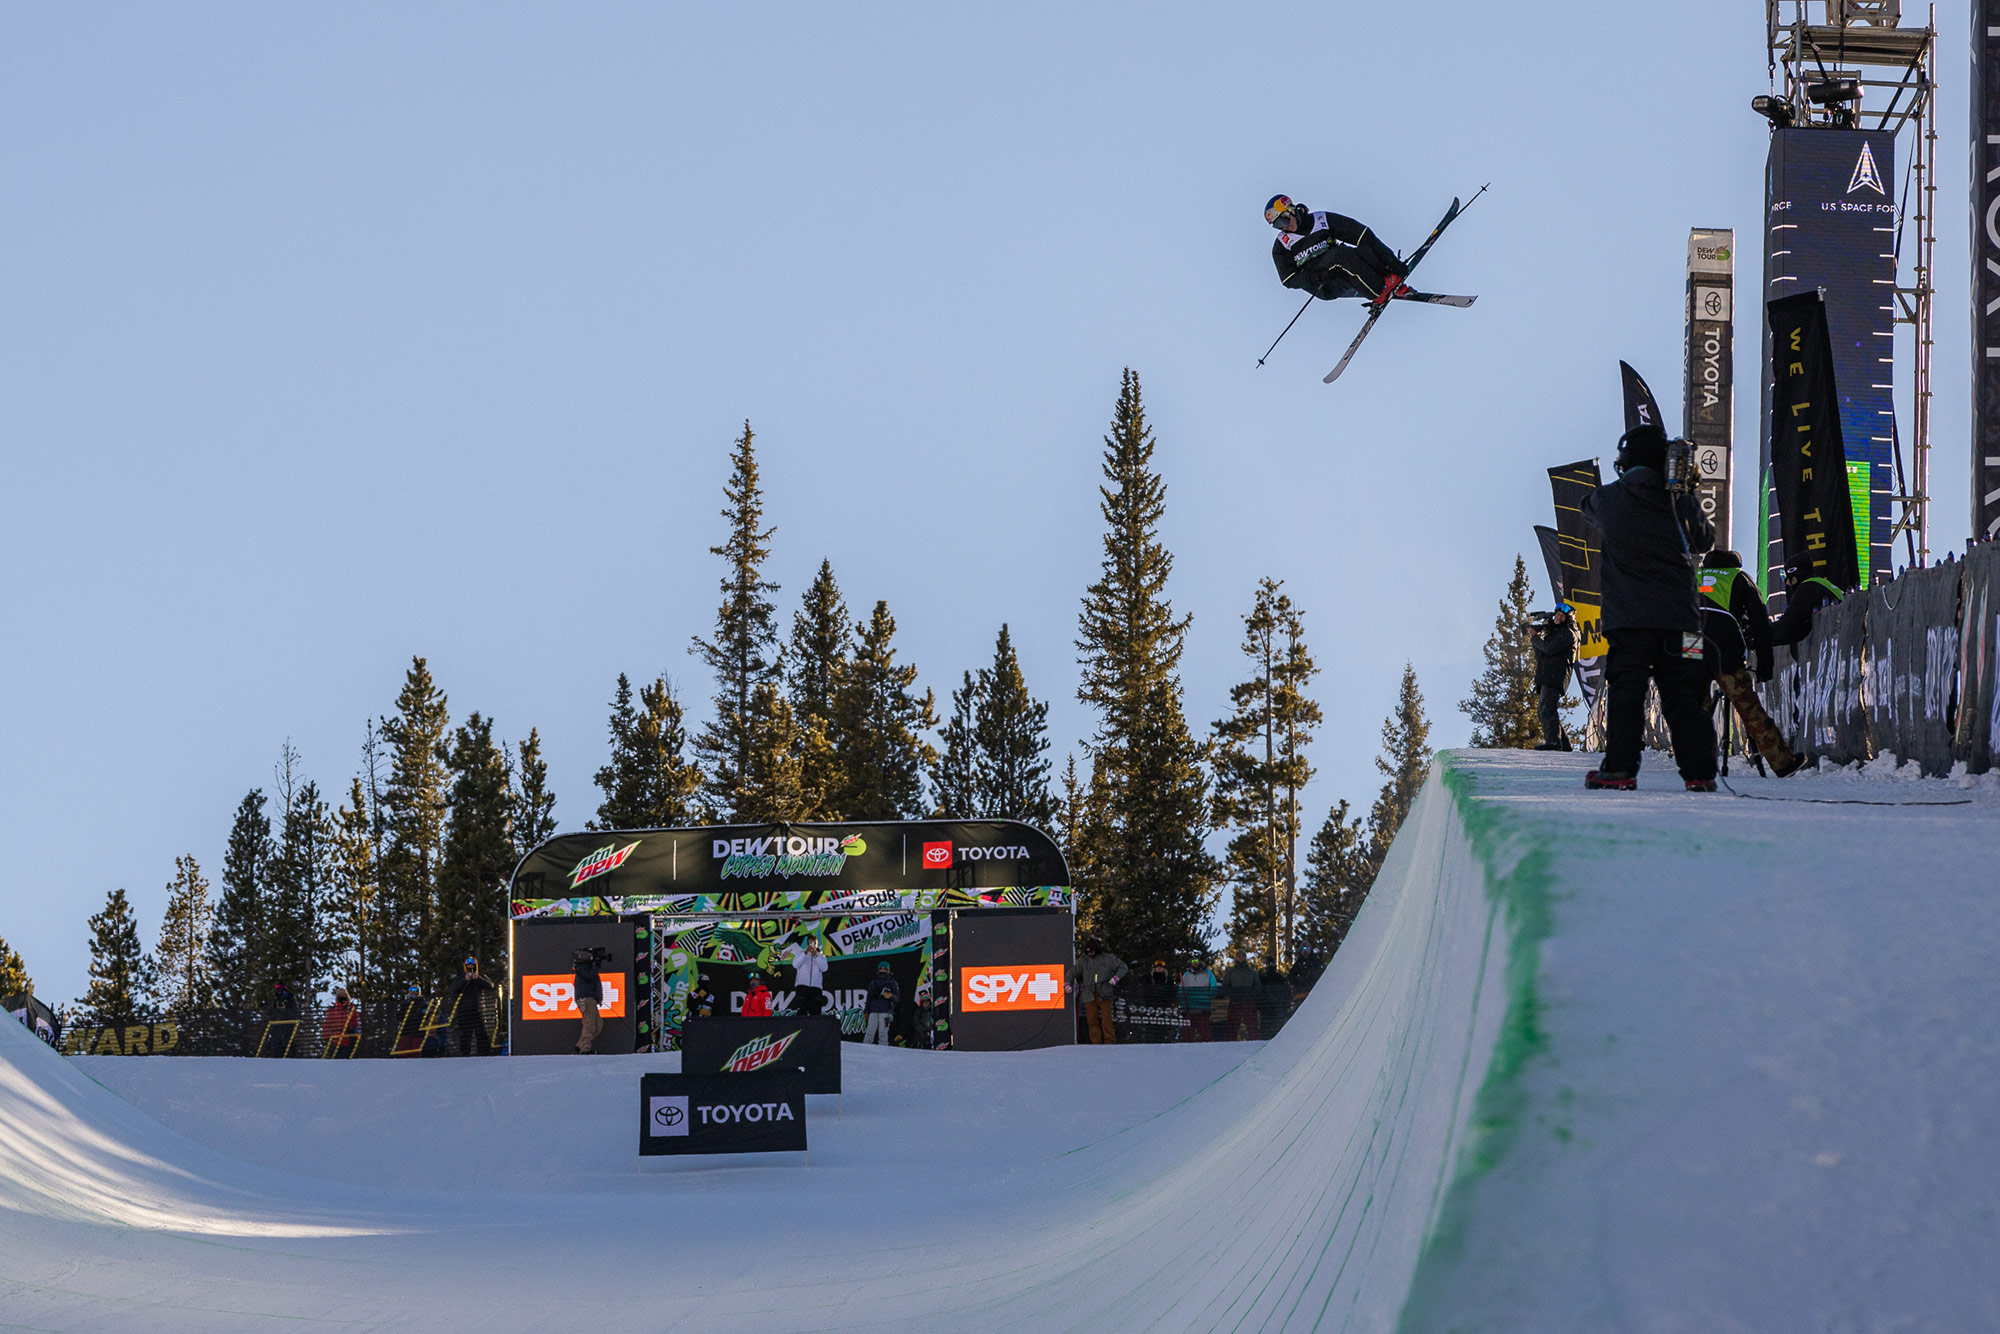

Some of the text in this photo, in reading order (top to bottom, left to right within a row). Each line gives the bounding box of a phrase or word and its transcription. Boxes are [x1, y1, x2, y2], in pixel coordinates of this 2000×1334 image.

[1821, 202, 1837, 211] US
[1841, 203, 1873, 212] SPACE
[1703, 327, 1720, 408] TOYOTA
[1789, 326, 1828, 579] WE LIVE THI
[720, 850, 847, 880] COPPER MOUNTAIN
[958, 846, 1030, 861] TOYOTA
[697, 1102, 795, 1124] TOYOTA
